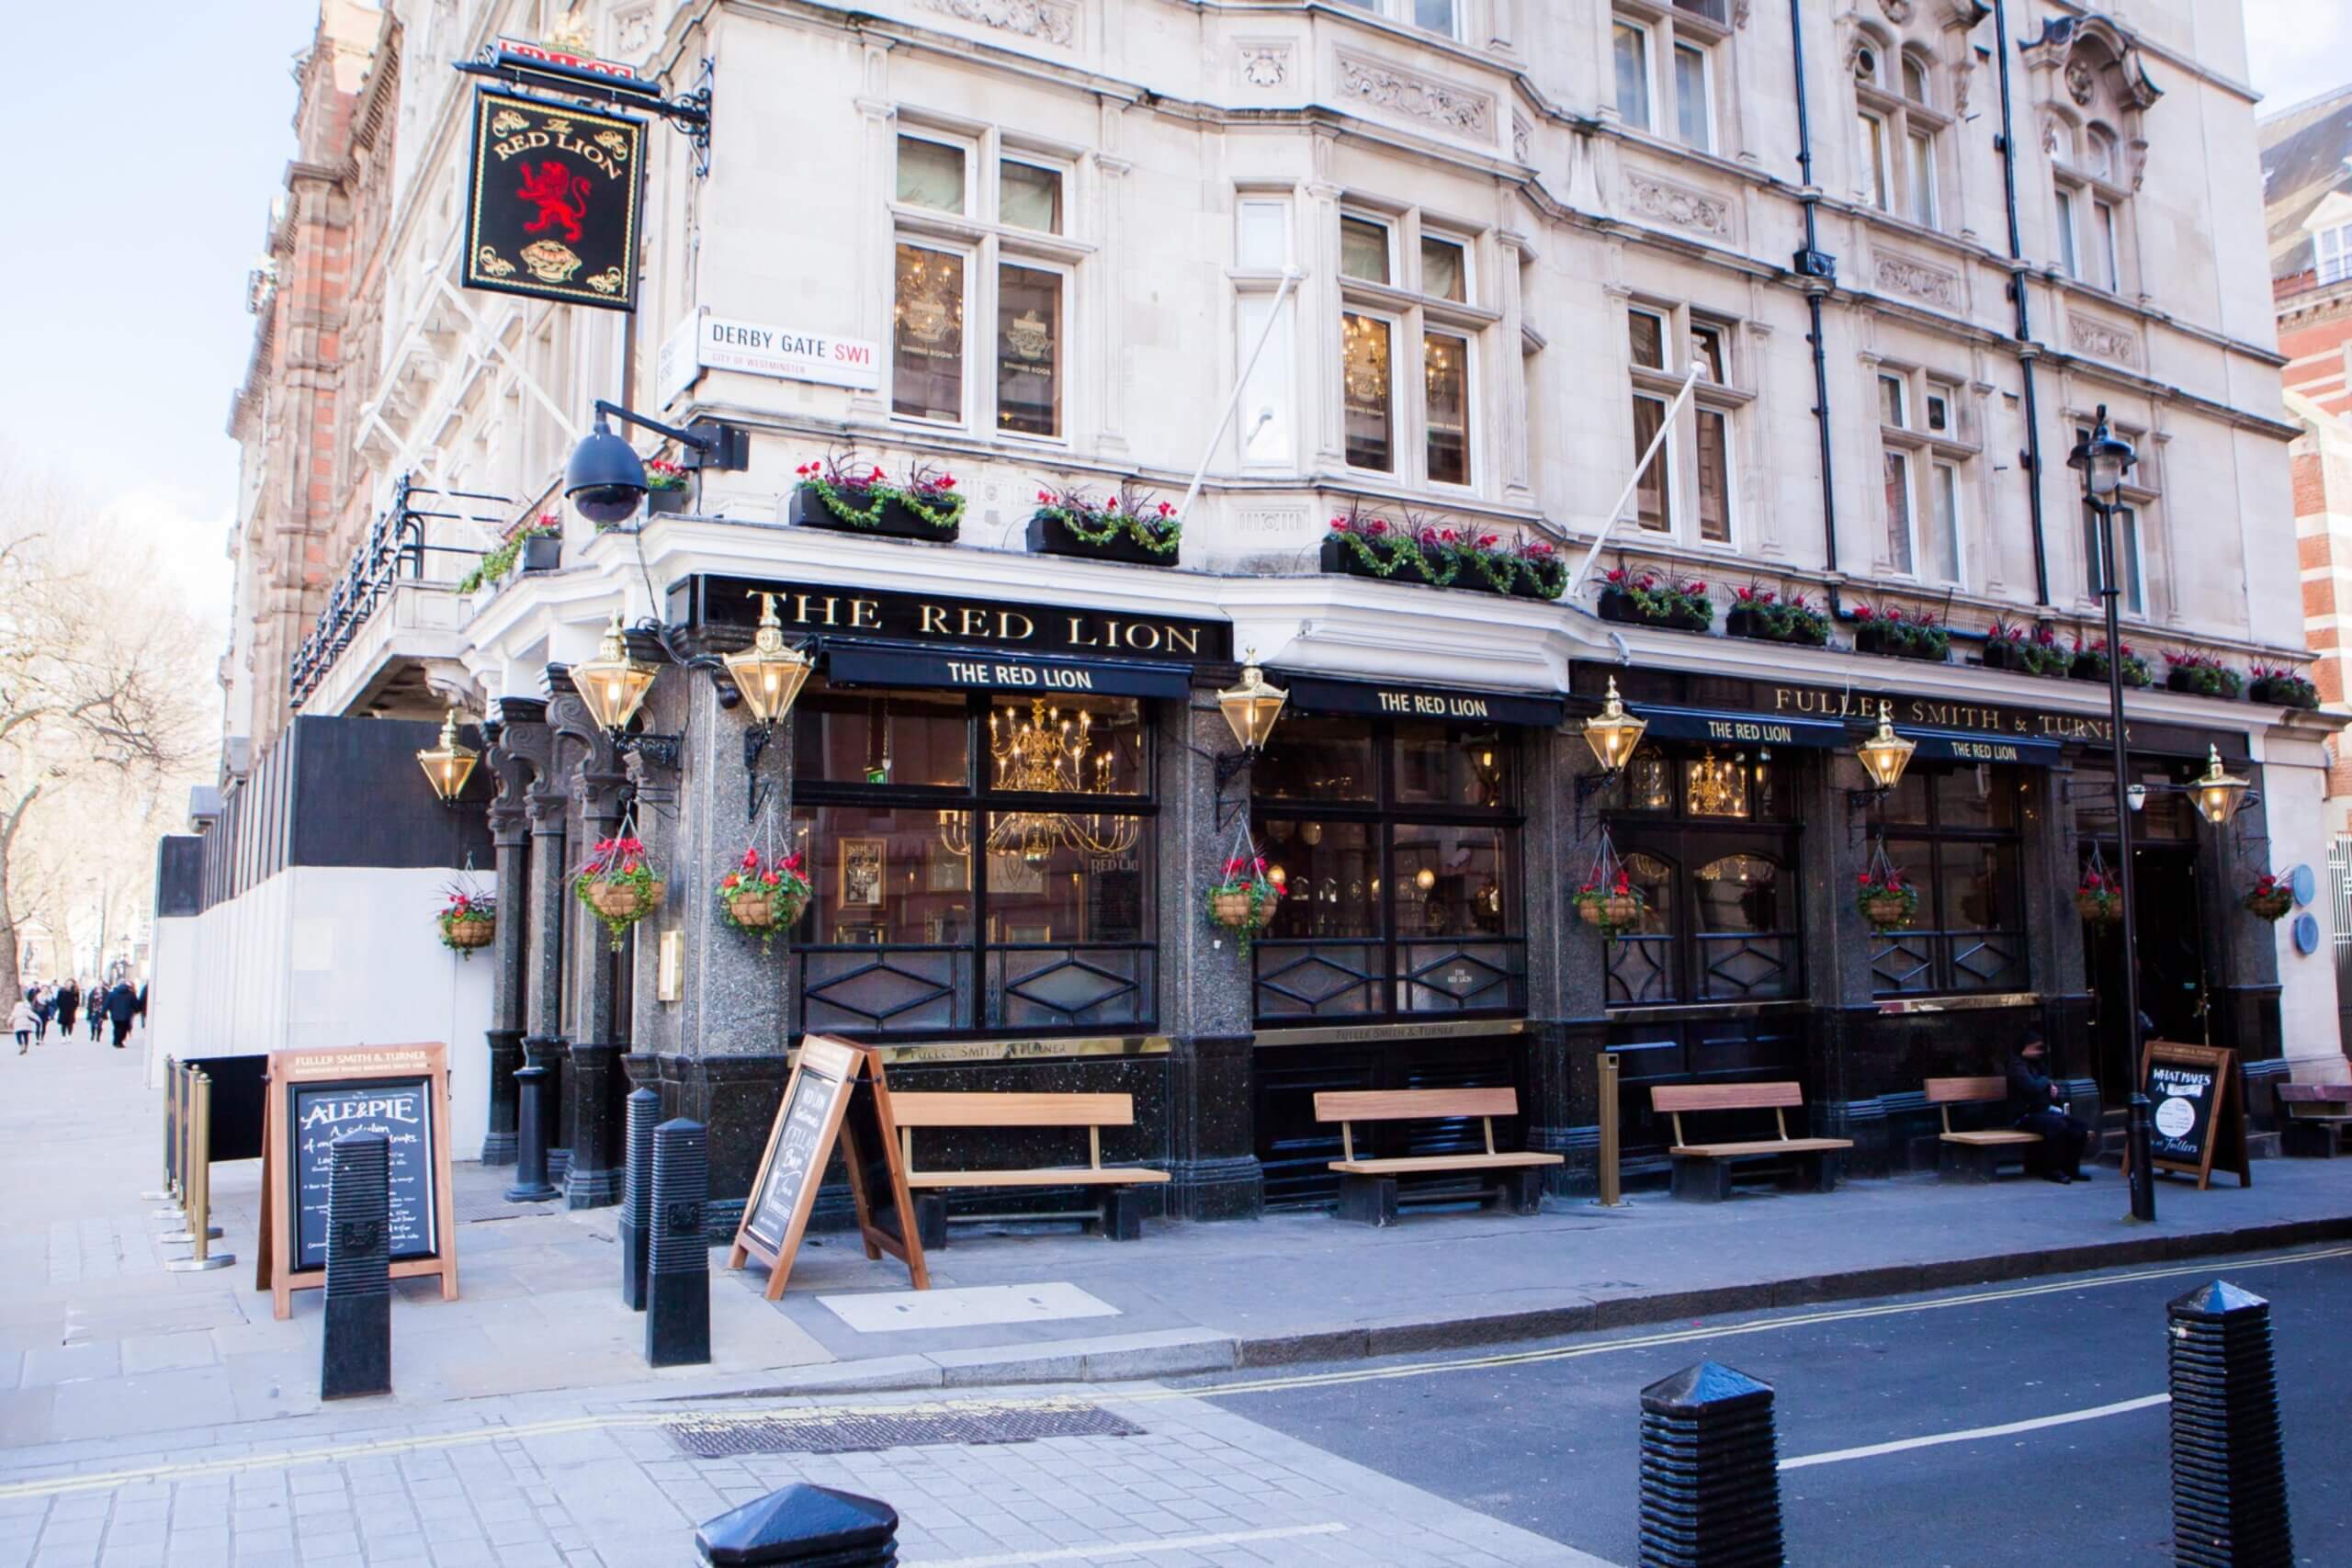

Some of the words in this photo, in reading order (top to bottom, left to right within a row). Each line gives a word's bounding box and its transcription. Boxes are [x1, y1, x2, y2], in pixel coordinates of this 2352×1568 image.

[494, 131, 550, 161] RED
[558, 133, 623, 180] LION
[713, 323, 774, 350] DERBY
[781, 334, 827, 357] GATE
[834, 343, 871, 365] SW1
[712, 352, 731, 362] CITY
[747, 357, 807, 375] WESTMINSTER
[746, 589, 882, 629] THE
[919, 604, 1035, 640] RED
[1067, 616, 1201, 654] LION
[947, 661, 990, 684] THE
[996, 666, 1037, 687] RED
[1043, 669, 1093, 689] LION
[1377, 693, 1411, 713] THE
[1415, 694, 1446, 715] RED
[1450, 698, 1488, 716] LION
[1775, 688, 1895, 720] FULLER
[1911, 700, 1999, 730] SMITH
[2014, 716, 2028, 732] &
[1708, 720, 1734, 739] THE
[1735, 723, 1760, 740] RED
[1762, 725, 1792, 742] LION
[1951, 741, 1972, 758] THE
[1972, 742, 1992, 759] RED
[1994, 745, 2018, 761] LION
[295, 1055, 334, 1066] FULLER
[336, 1053, 372, 1064] SMITH
[374, 1053, 383, 1062] &
[386, 1050, 426, 1061] TURNER
[2154, 1068, 2181, 1082] WHAT
